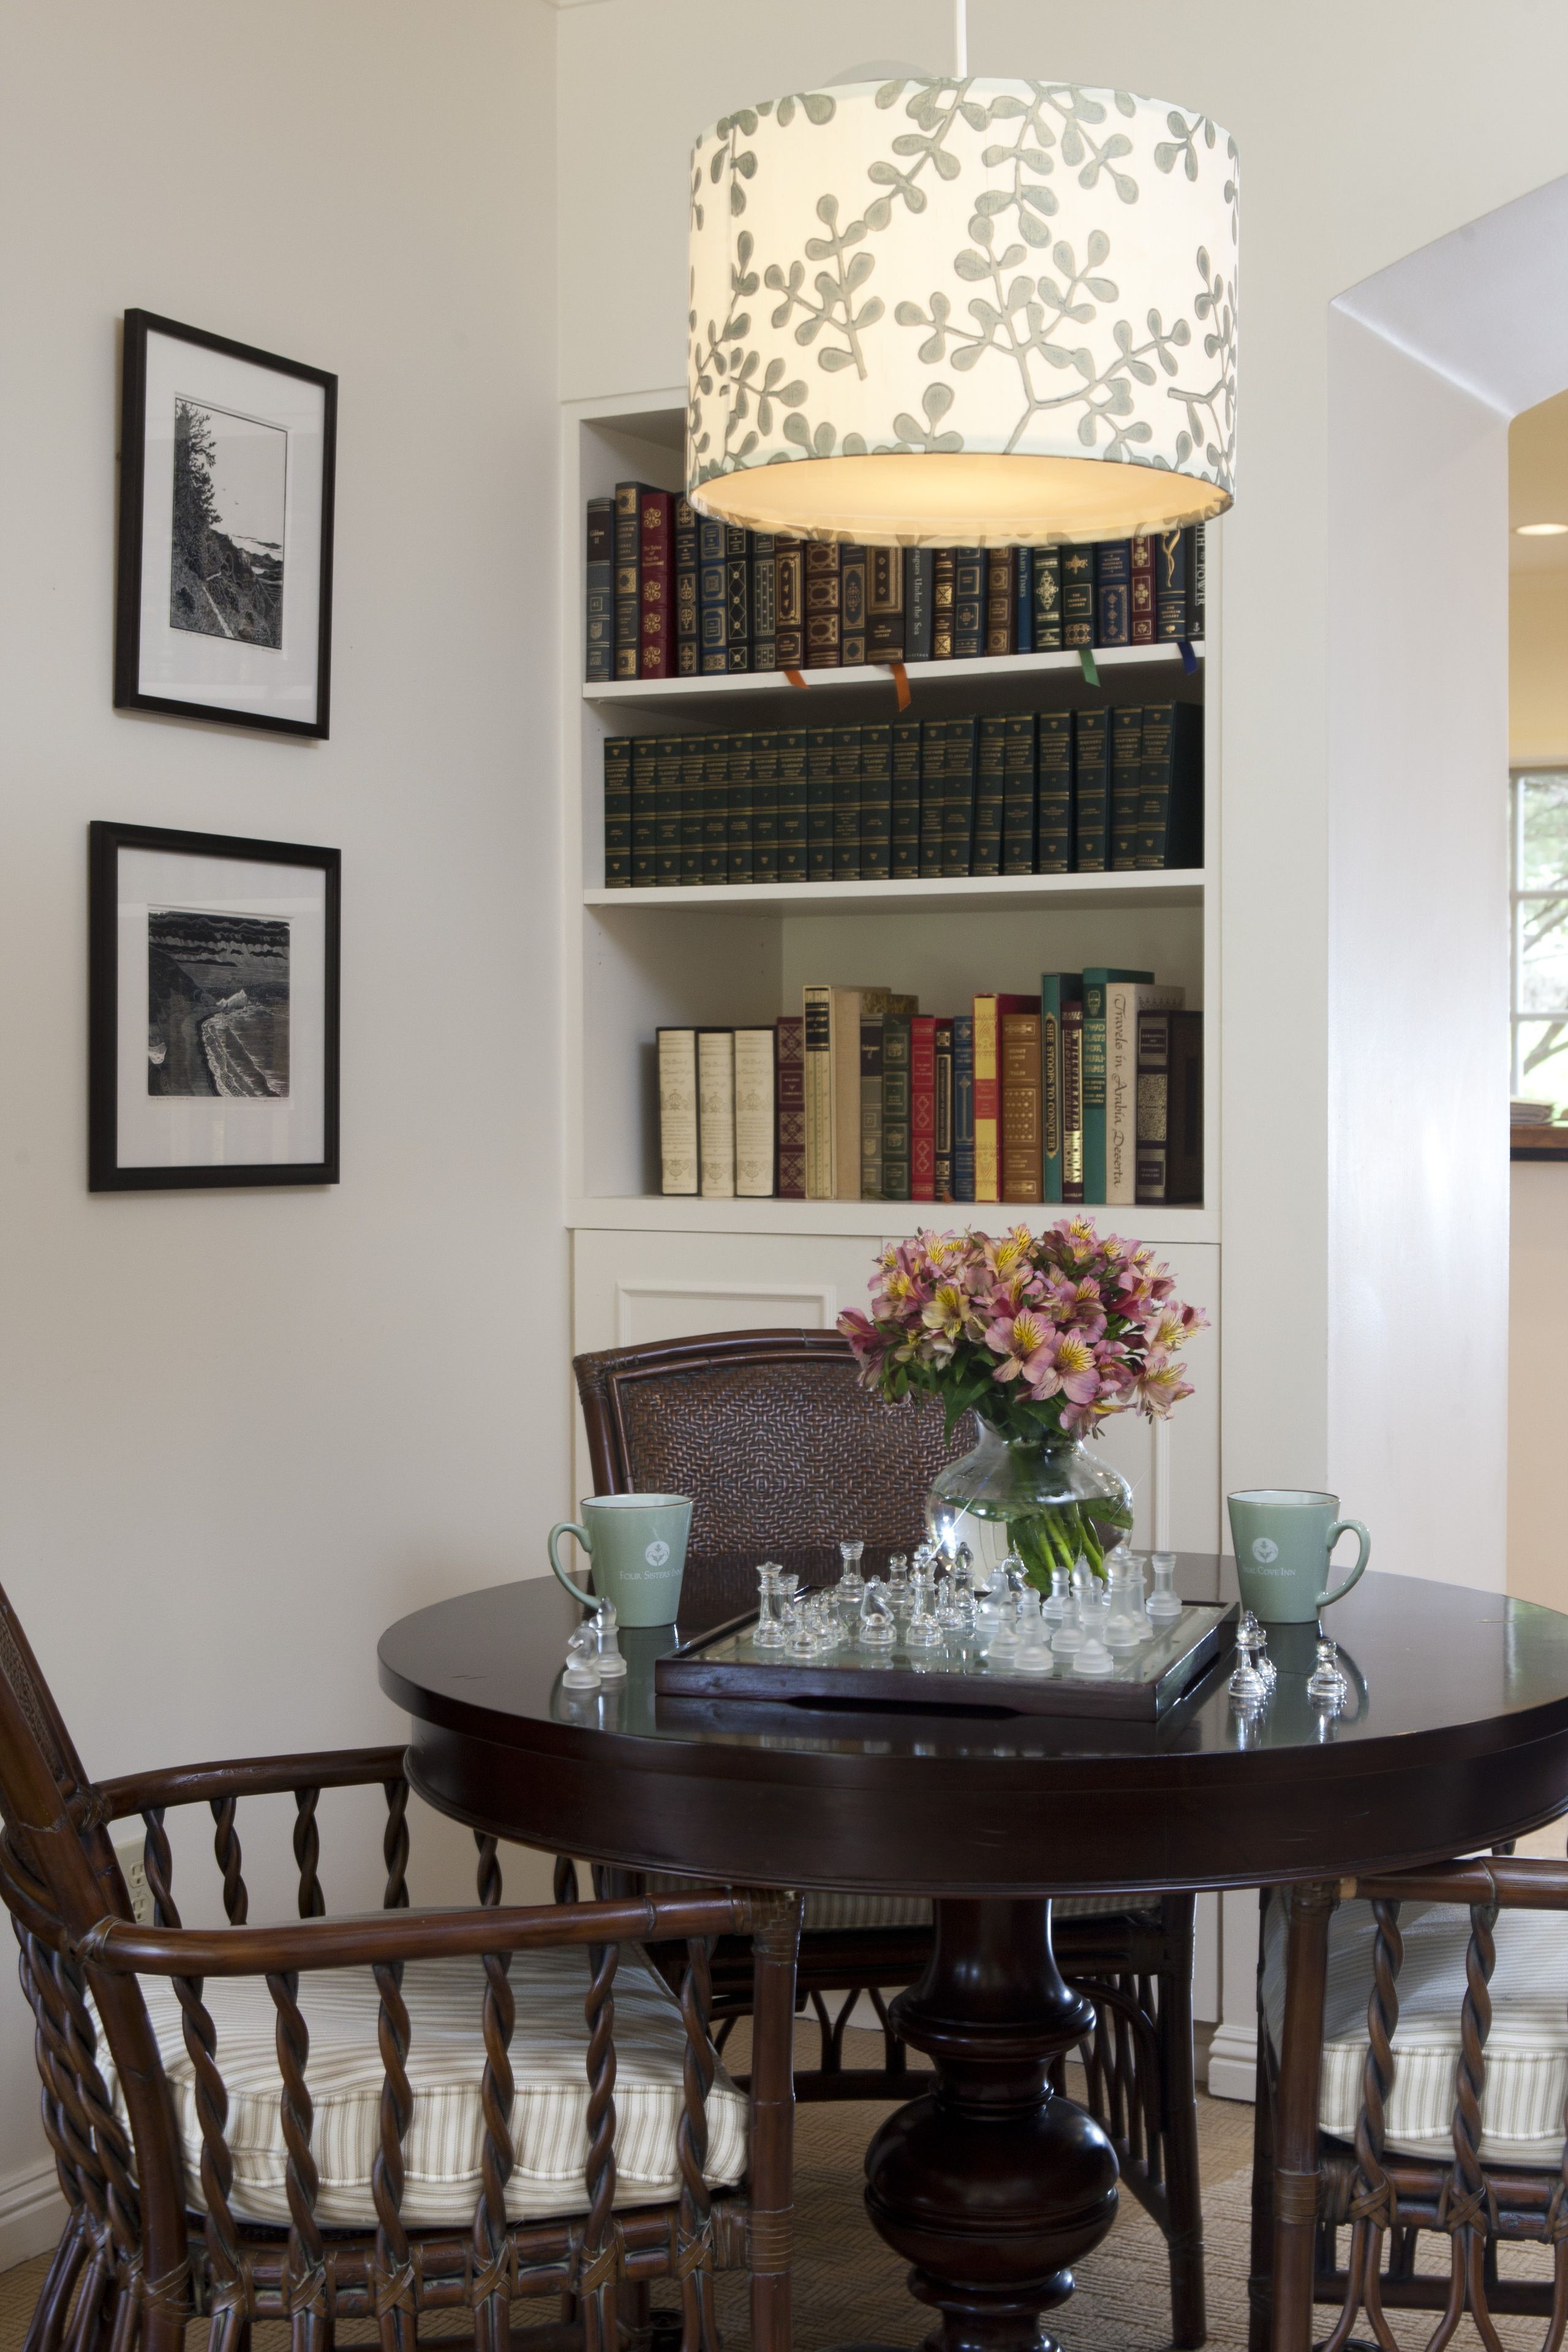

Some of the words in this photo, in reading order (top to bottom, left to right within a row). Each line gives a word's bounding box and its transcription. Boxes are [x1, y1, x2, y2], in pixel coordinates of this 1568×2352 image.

[1114, 994, 1127, 1050] Travels
[1115, 1056, 1125, 1070] in
[1046, 1087, 1054, 1099] TO
[1112, 1074, 1127, 1124] Arabia
[1046, 1102, 1054, 1148] CONQUER
[1113, 1131, 1125, 1188] Deserta
[620, 1570, 642, 1580] FOUR
[644, 1571, 670, 1579] SISTERS
[1258, 1566, 1279, 1576] COVE
[1281, 1567, 1296, 1576] INN
